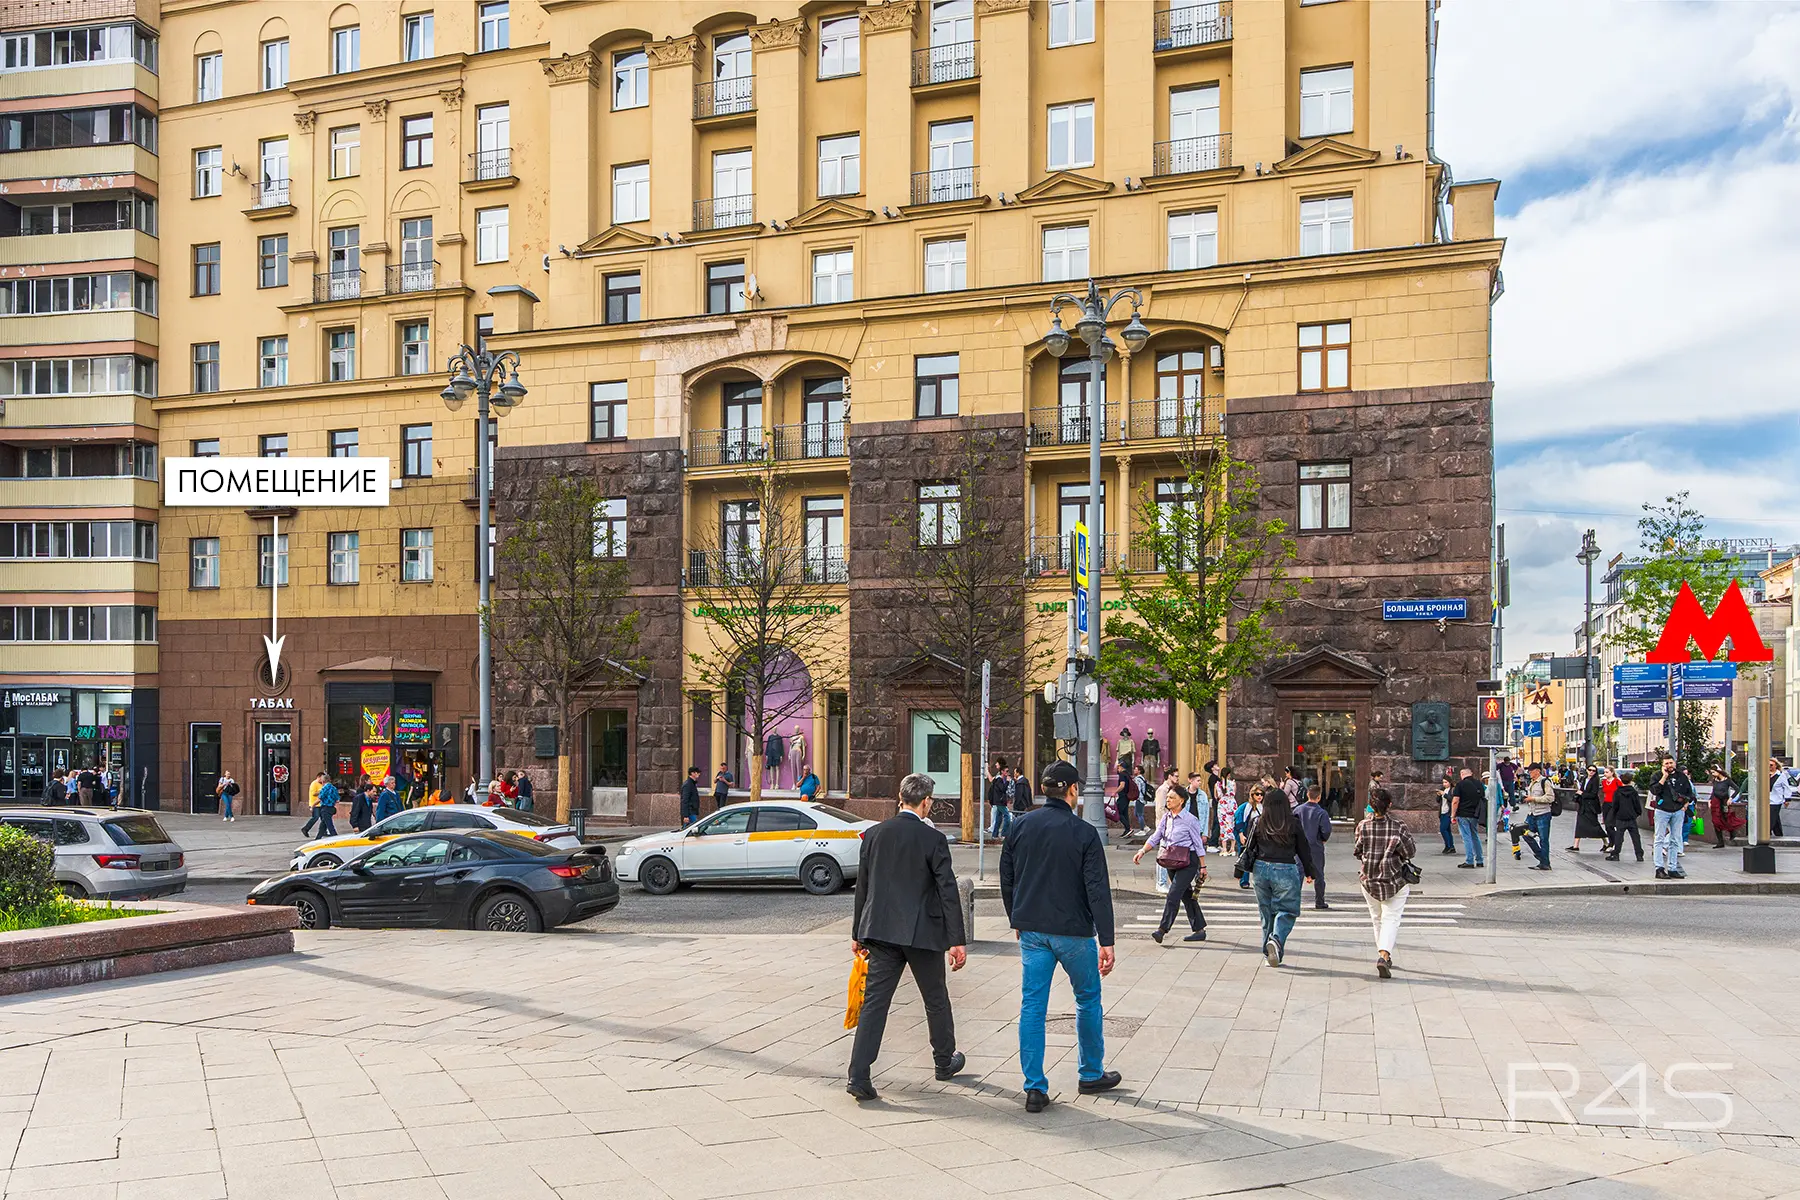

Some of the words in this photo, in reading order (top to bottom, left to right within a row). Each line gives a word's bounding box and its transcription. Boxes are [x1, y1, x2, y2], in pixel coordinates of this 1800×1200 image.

[1036, 601, 1068, 612] UNITE
[1386, 604, 1424, 612] БОЛЬШАЯ
[1427, 603, 1464, 611] БРОННАЯ
[12, 692, 59, 702] МосТАБАК
[249, 698, 293, 709] ТАБАК
[22, 767, 43, 775] ТАБАК
